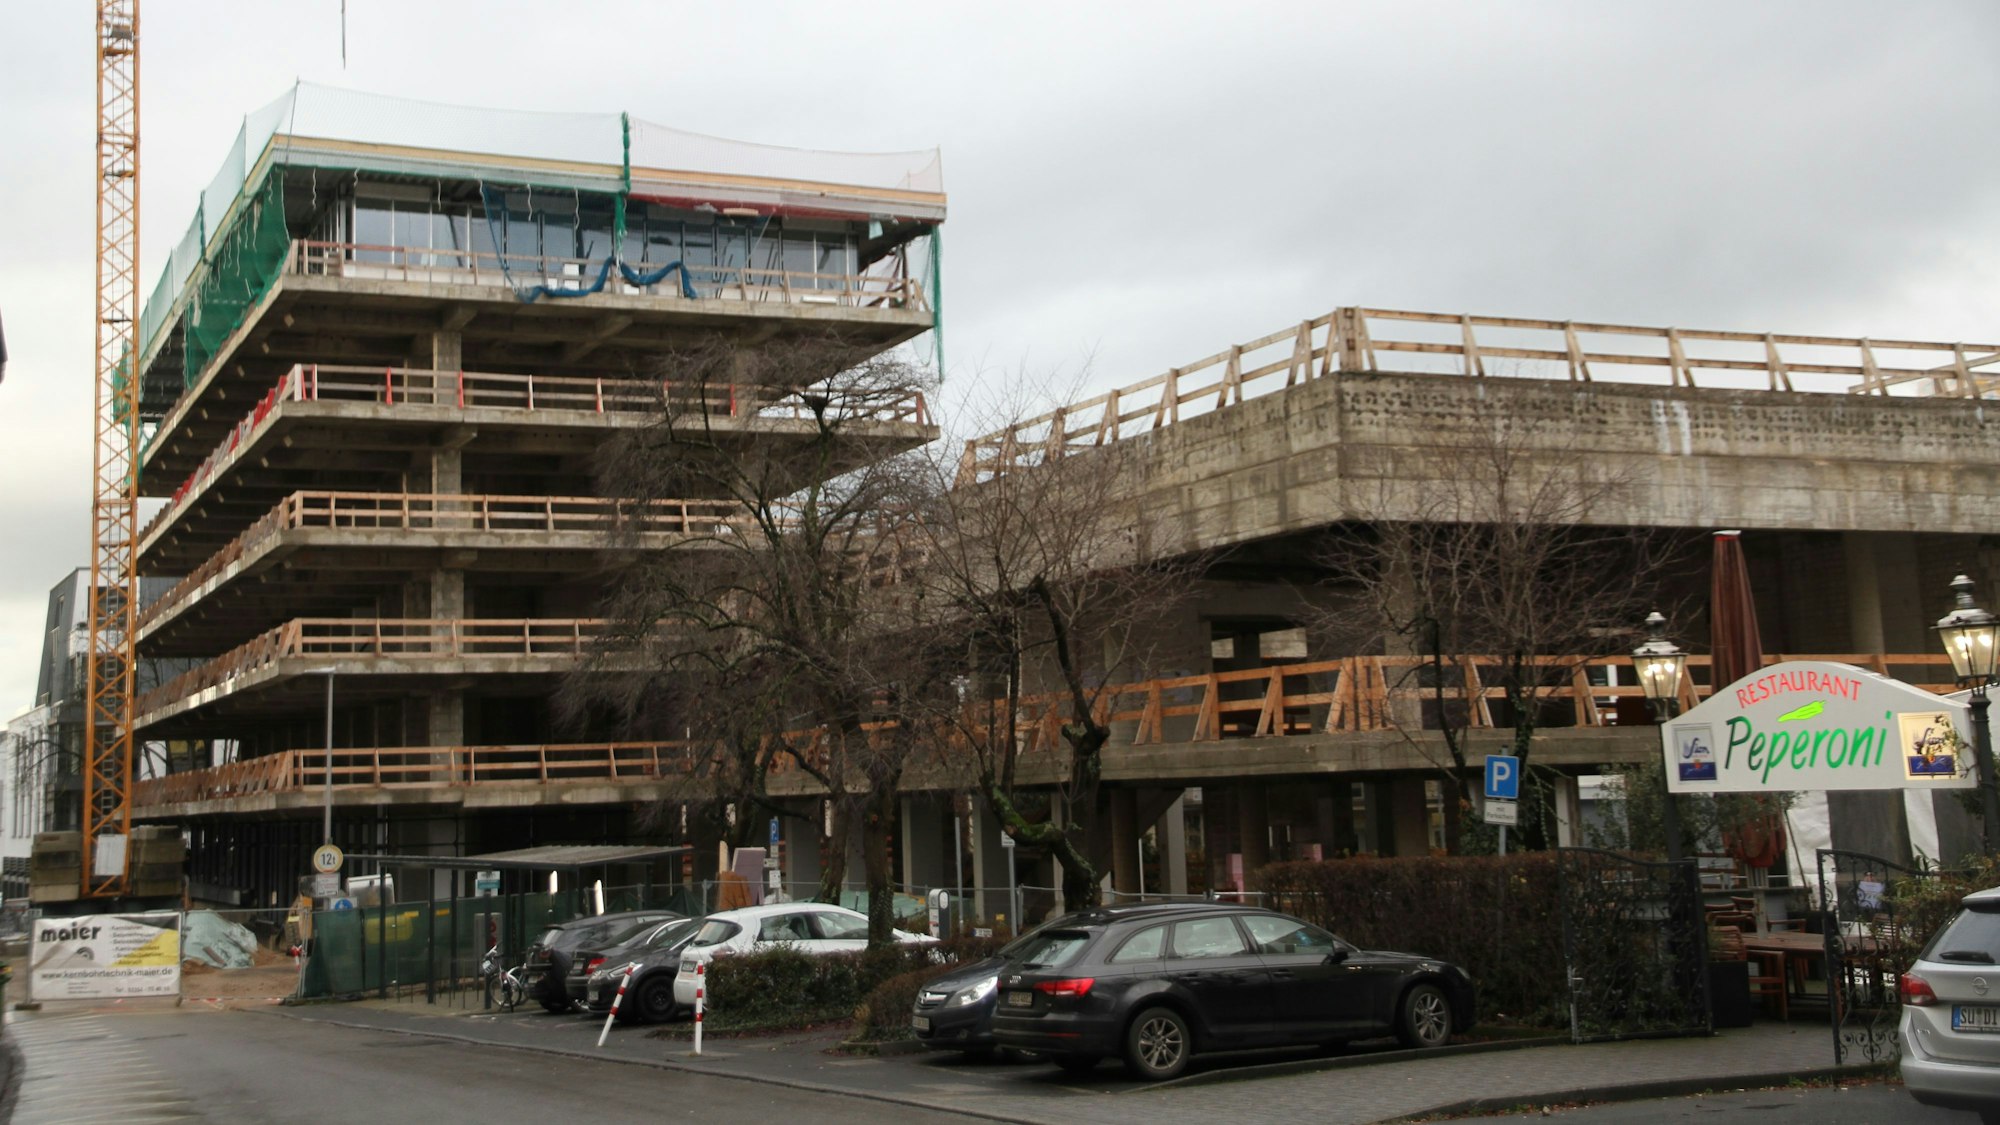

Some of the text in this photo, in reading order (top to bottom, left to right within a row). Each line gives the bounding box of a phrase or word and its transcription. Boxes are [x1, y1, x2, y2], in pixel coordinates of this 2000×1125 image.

[1736, 671, 1862, 709] RESTAURANT
[1724, 710, 1892, 784] Peperoni
[1492, 761, 1511, 792] P
[40, 921, 102, 943] maier
[41, 967, 173, 980] www.kernbohrtechnik-maier.de
[1961, 1008, 1975, 1025] SU
